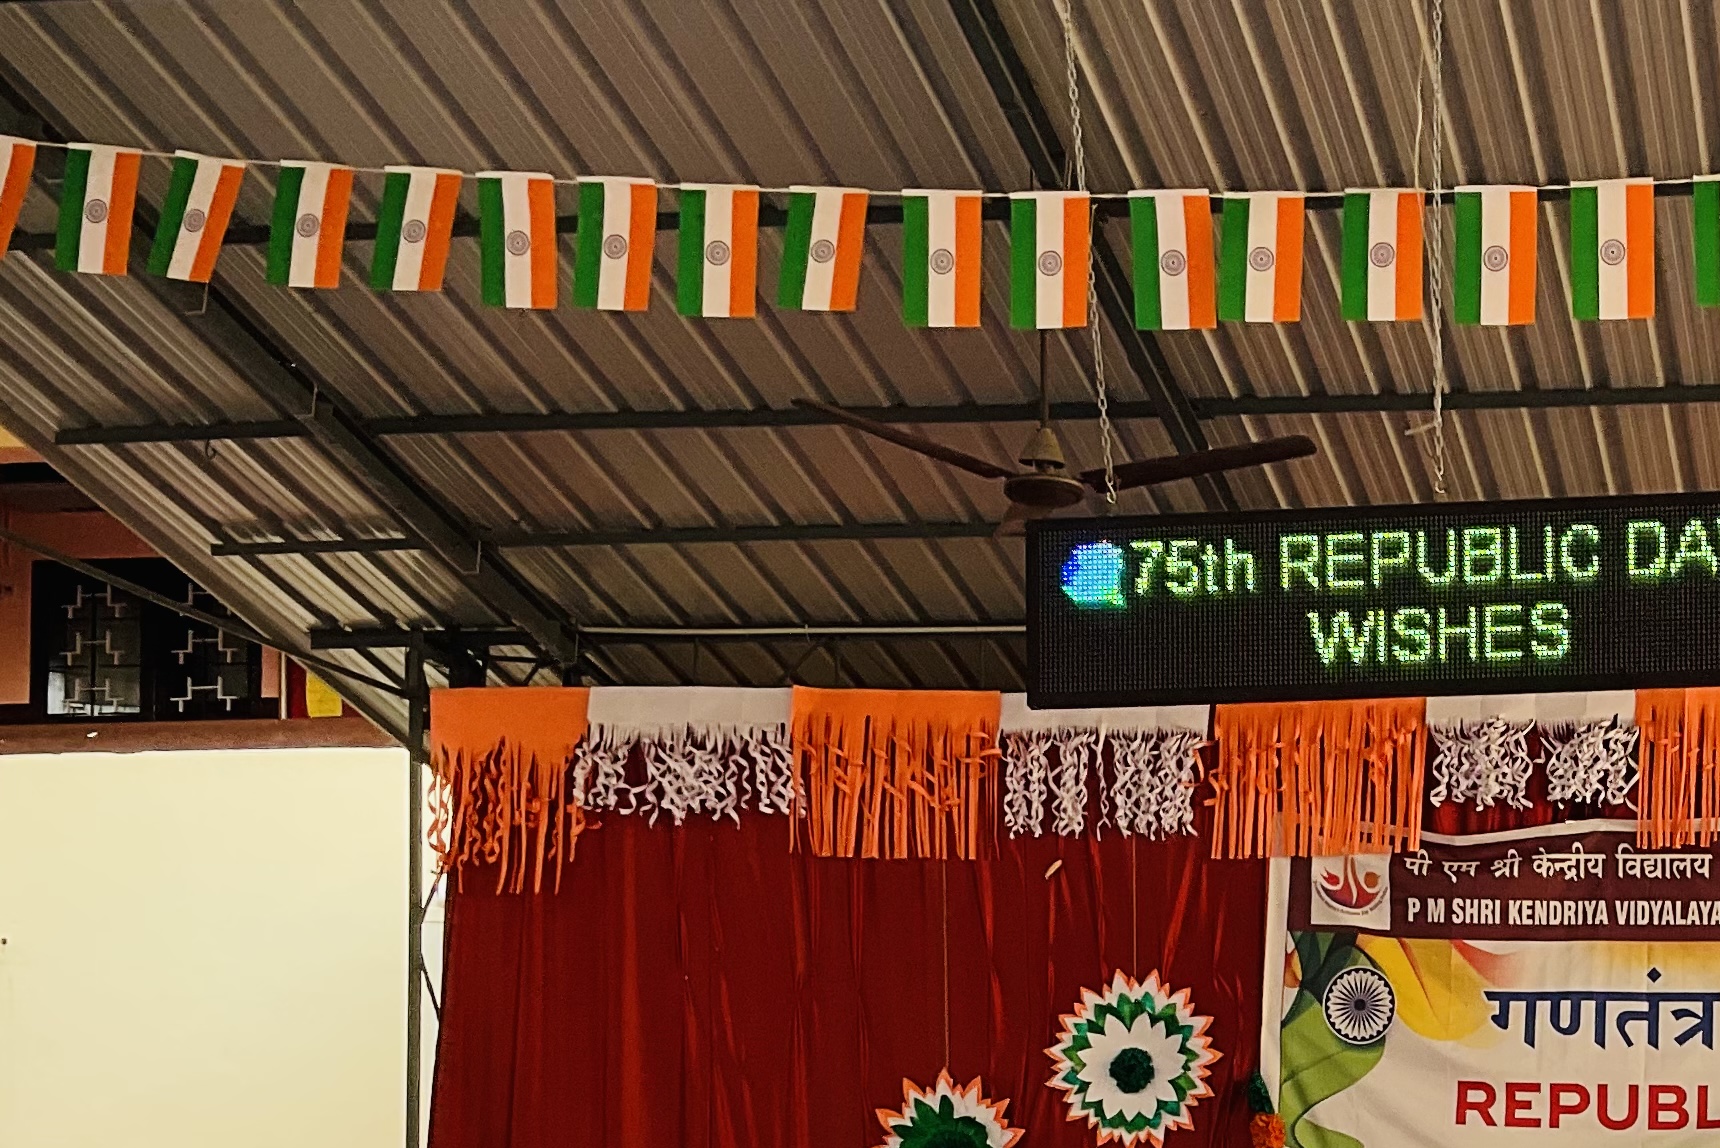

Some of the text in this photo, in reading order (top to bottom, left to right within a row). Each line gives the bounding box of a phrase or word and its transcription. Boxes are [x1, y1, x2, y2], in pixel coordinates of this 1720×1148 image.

[1129, 536, 1255, 595] 75th
[1279, 523, 1600, 589] REPUBLIC
[1306, 602, 1571, 665] WISHES
[1403, 848, 1433, 877] पी
[1442, 860, 1480, 883] एम
[1490, 849, 1523, 879] श्री
[1531, 841, 1607, 882] केन्द्रीय
[1615, 842, 1713, 880] विद्यालय
[1407, 898, 1421, 923] P
[1427, 898, 1445, 924] M
[1451, 897, 1501, 925] SHRI
[1508, 899, 1609, 926] KENDRIYA
